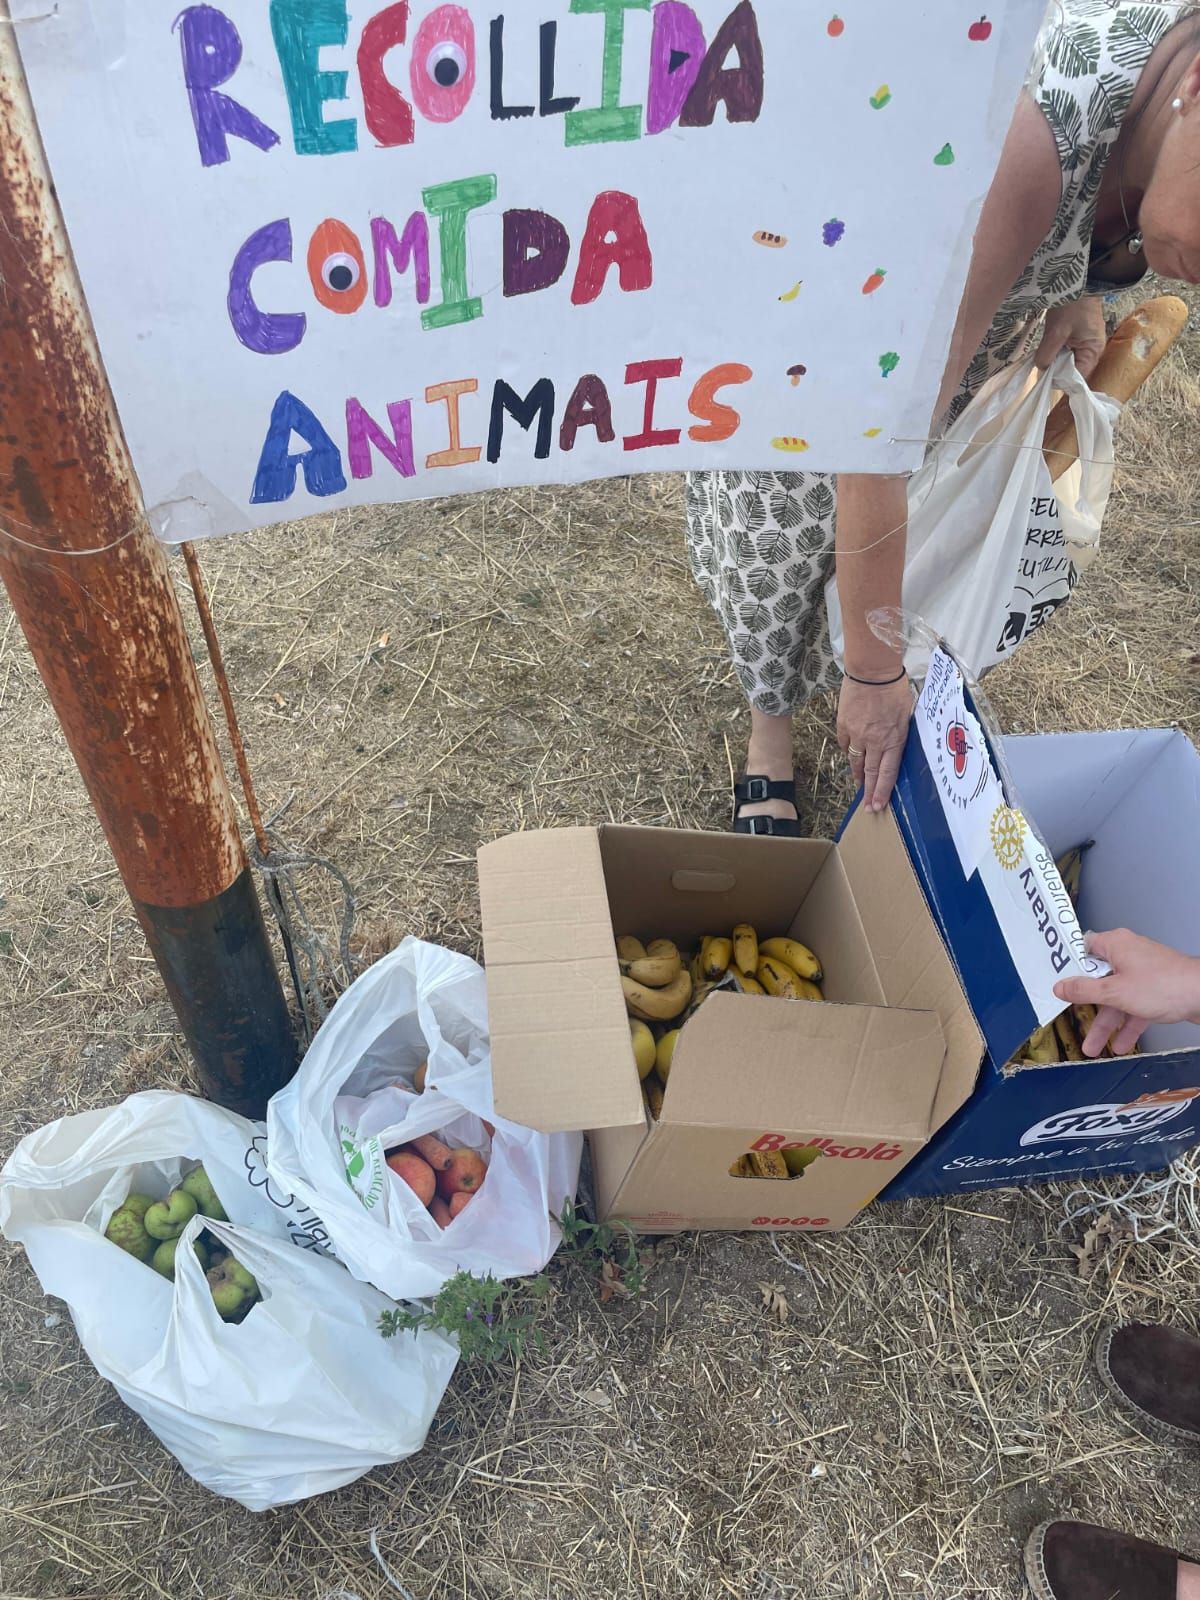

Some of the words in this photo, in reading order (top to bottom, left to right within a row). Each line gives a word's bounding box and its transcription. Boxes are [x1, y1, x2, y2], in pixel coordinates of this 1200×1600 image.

[171, 0, 764, 167] RECOLLIDA
[226, 173, 654, 354] COMIDA
[249, 356, 754, 504] ANIMAIS
[1019, 866, 1071, 974] Rotary
[1035, 853, 1075, 925] Ourense
[942, 1149, 1064, 1170] Siempre
[1066, 1146, 1090, 1156] a
[1095, 1138, 1128, 1152] tu
[1037, 1105, 1178, 1139] Foxy
